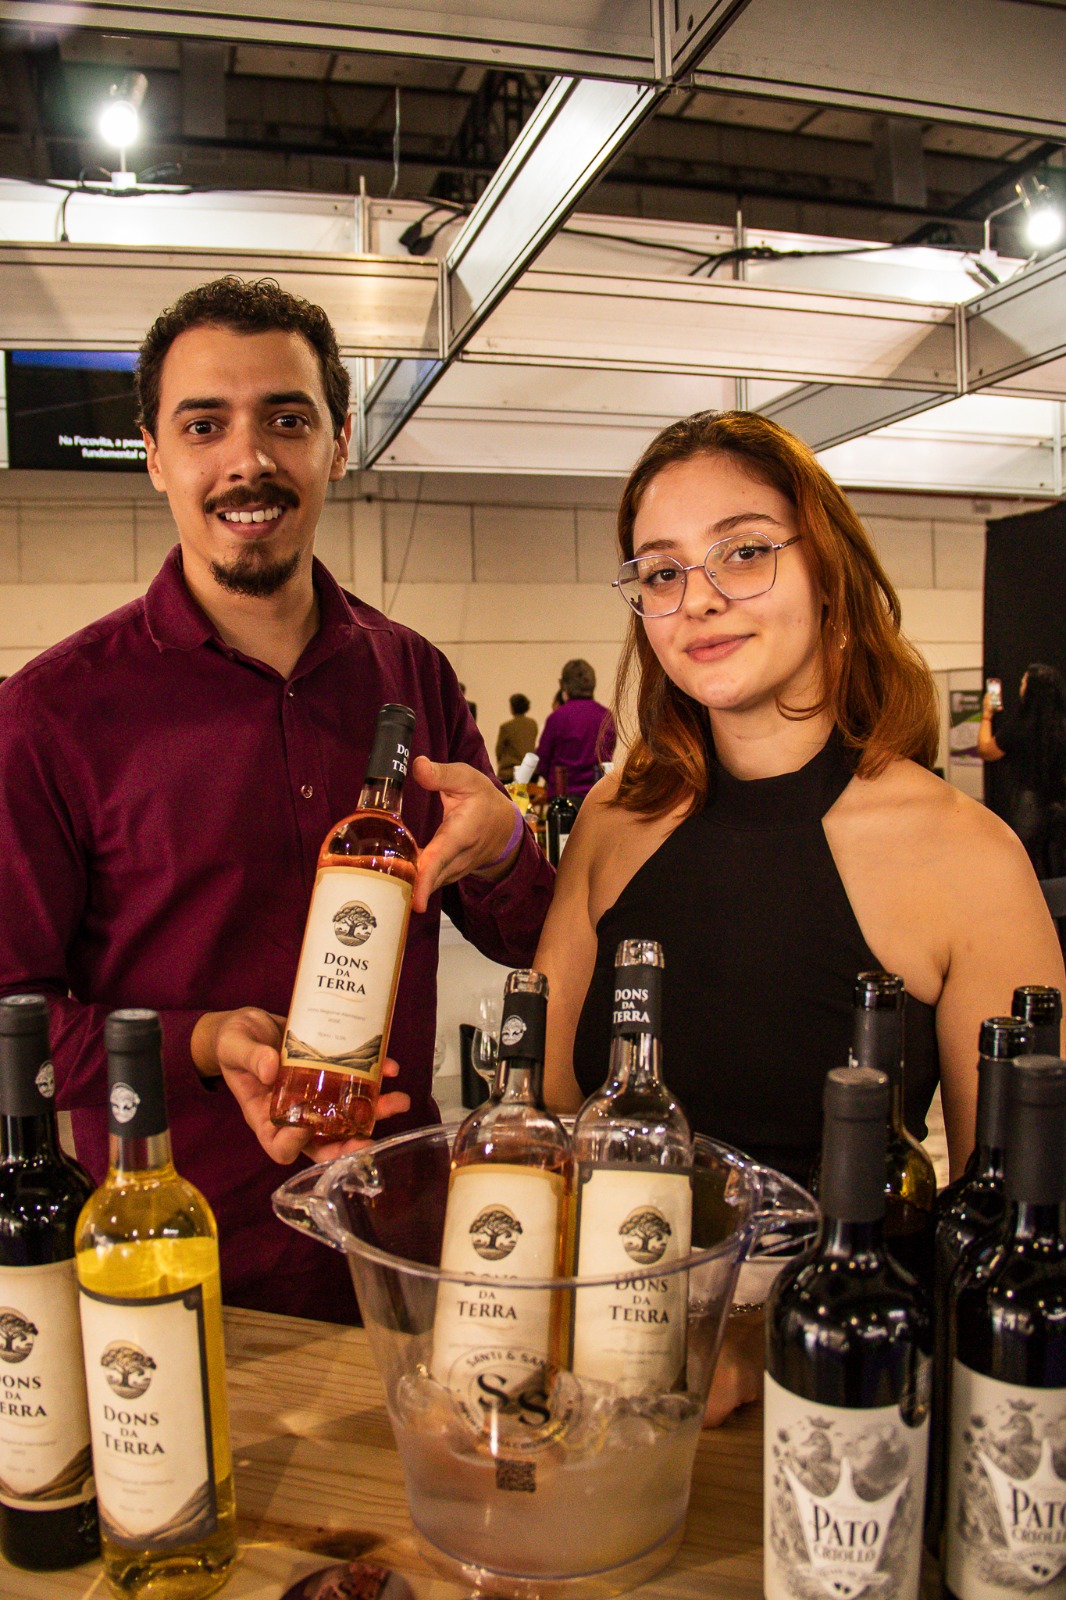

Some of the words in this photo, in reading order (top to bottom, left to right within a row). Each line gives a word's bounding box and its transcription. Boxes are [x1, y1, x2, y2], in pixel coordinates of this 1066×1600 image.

[396, 743, 410, 758] DO
[323, 952, 370, 971] DONS
[335, 968, 350, 978] DA
[316, 974, 366, 995] TERRA
[614, 988, 649, 1003] DONS
[621, 1000, 636, 1010] DA
[478, 1289, 496, 1300] DA
[632, 1294, 651, 1306] DA
[456, 1300, 518, 1321] TERRA
[608, 1304, 670, 1324] TERRA
[0, 1374, 42, 1390] ONS
[5, 1390, 22, 1401] DA
[0, 1401, 48, 1418] ERRA
[103, 1404, 160, 1427] DONS
[120, 1427, 138, 1439] DA
[101, 1431, 166, 1456] TERRA
[813, 1503, 880, 1548] PATO
